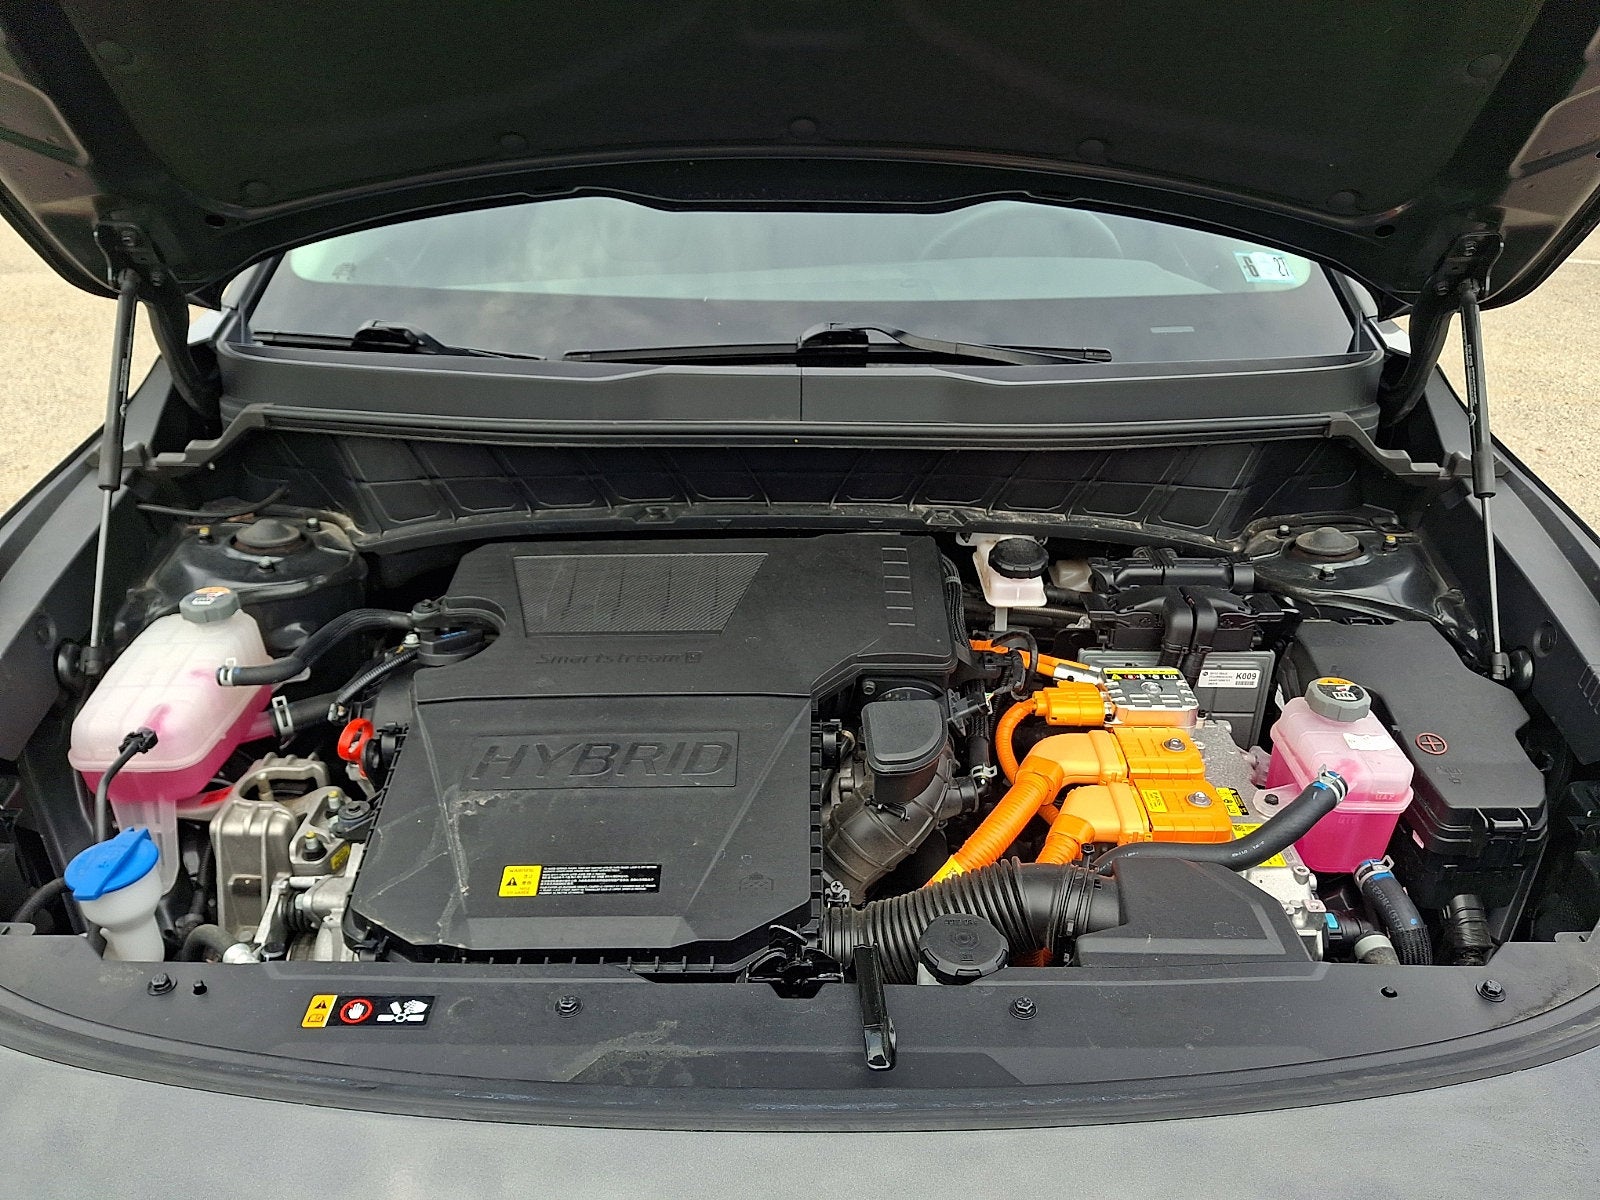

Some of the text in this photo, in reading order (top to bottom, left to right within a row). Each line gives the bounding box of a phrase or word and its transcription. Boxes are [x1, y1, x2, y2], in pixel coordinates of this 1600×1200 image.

[536, 651, 682, 664] Smartstream
[1235, 672, 1257, 680] K009
[470, 741, 733, 780] HYBRID
